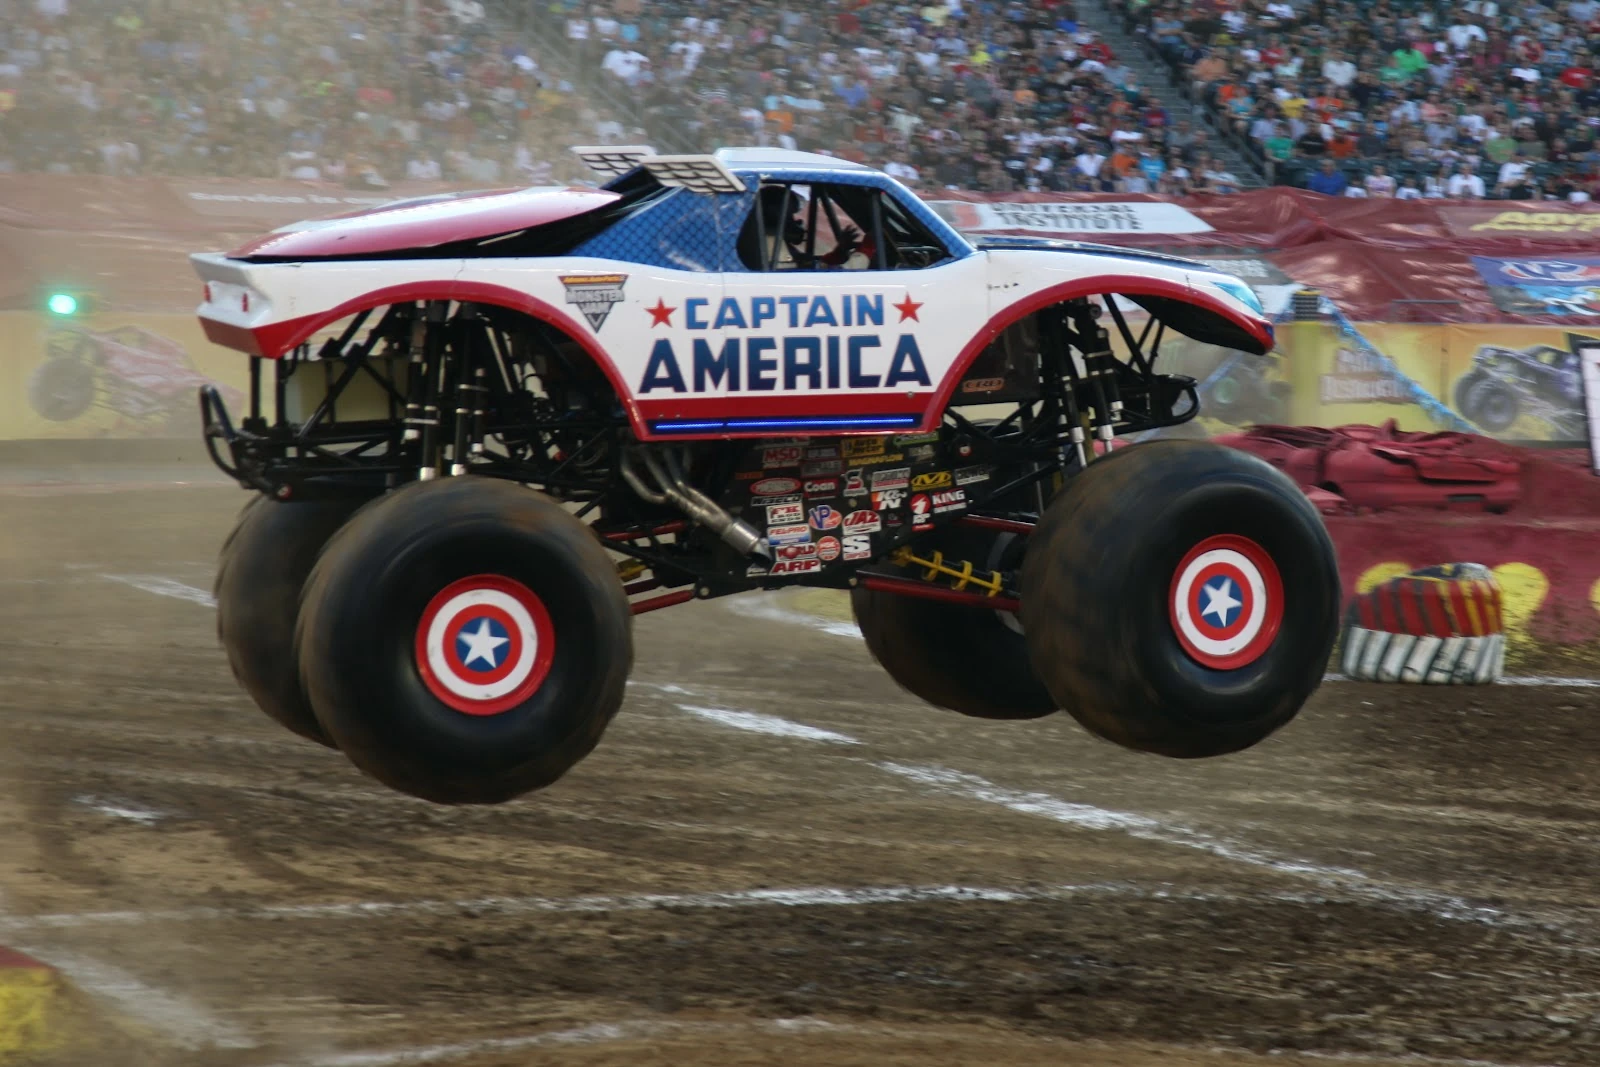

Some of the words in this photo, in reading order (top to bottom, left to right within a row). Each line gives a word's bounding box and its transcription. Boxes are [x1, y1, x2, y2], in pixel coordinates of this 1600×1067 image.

[566, 289, 624, 303] MONSTER
[685, 294, 884, 329] CAPTAIN
[638, 334, 932, 393] AMERICA
[766, 446, 799, 460] MSD
[804, 481, 835, 492] Coan
[878, 490, 907, 510] K&N
[932, 491, 965, 504] KING
[808, 504, 832, 529] VP
[844, 510, 878, 526] JAZ
[777, 545, 815, 558] WORLD
[772, 560, 819, 573] ARP
